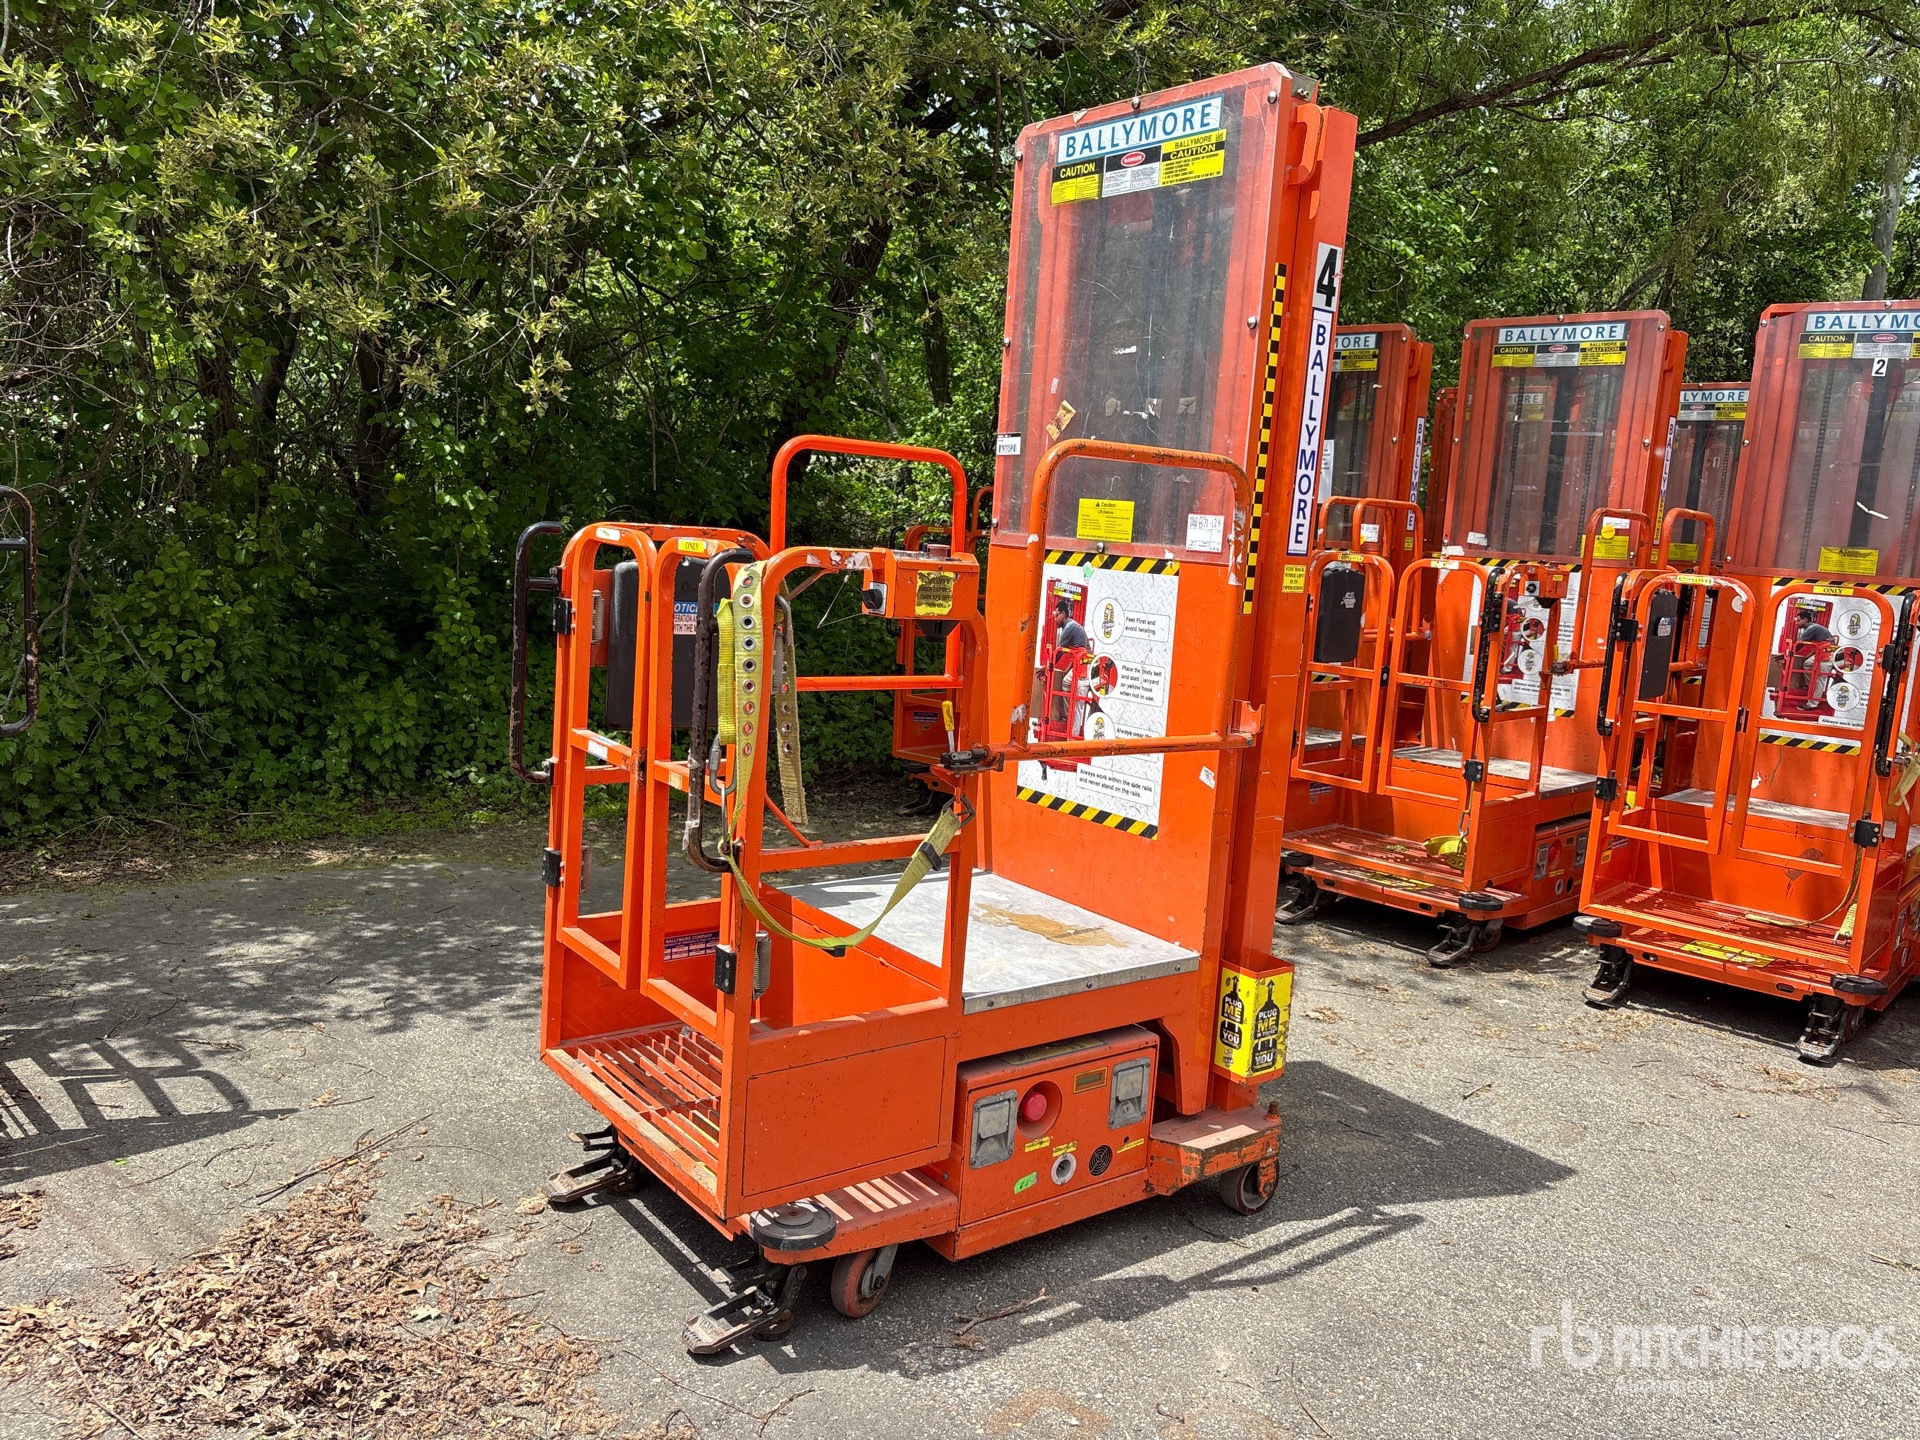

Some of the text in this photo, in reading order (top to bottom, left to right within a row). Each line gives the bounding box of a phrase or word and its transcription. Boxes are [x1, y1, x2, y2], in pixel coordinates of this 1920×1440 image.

[1066, 103, 1212, 158] BALLYMORE
[1175, 135, 1212, 149] BALLYMORE
[1170, 144, 1216, 159] CAUTION
[1060, 162, 1096, 178] CAUTION
[1316, 248, 1339, 308] 4
[1505, 325, 1618, 342] BALLYMORE
[1874, 359, 1886, 375] 2
[1683, 391, 1745, 402] LYMORE
[1294, 324, 1328, 545] BALLYMORE
[685, 541, 700, 551] ONLY
[1138, 627, 1157, 635] twisting.
[1117, 727, 1132, 736] Always
[1080, 768, 1095, 777] Always
[1096, 772, 1107, 780] work
[1108, 775, 1122, 783] within
[1131, 781, 1141, 789] side
[1142, 784, 1152, 792] rails
[1101, 782, 1114, 791] stand
[1130, 790, 1141, 798] rails.
[1225, 996, 1242, 1009] PLUG
[1224, 1002, 1242, 1019] ME
[1258, 1008, 1278, 1020] PLUG
[1258, 1016, 1277, 1032] ME
[1222, 1030, 1240, 1045] YOU
[1255, 1052, 1274, 1065] YOU
